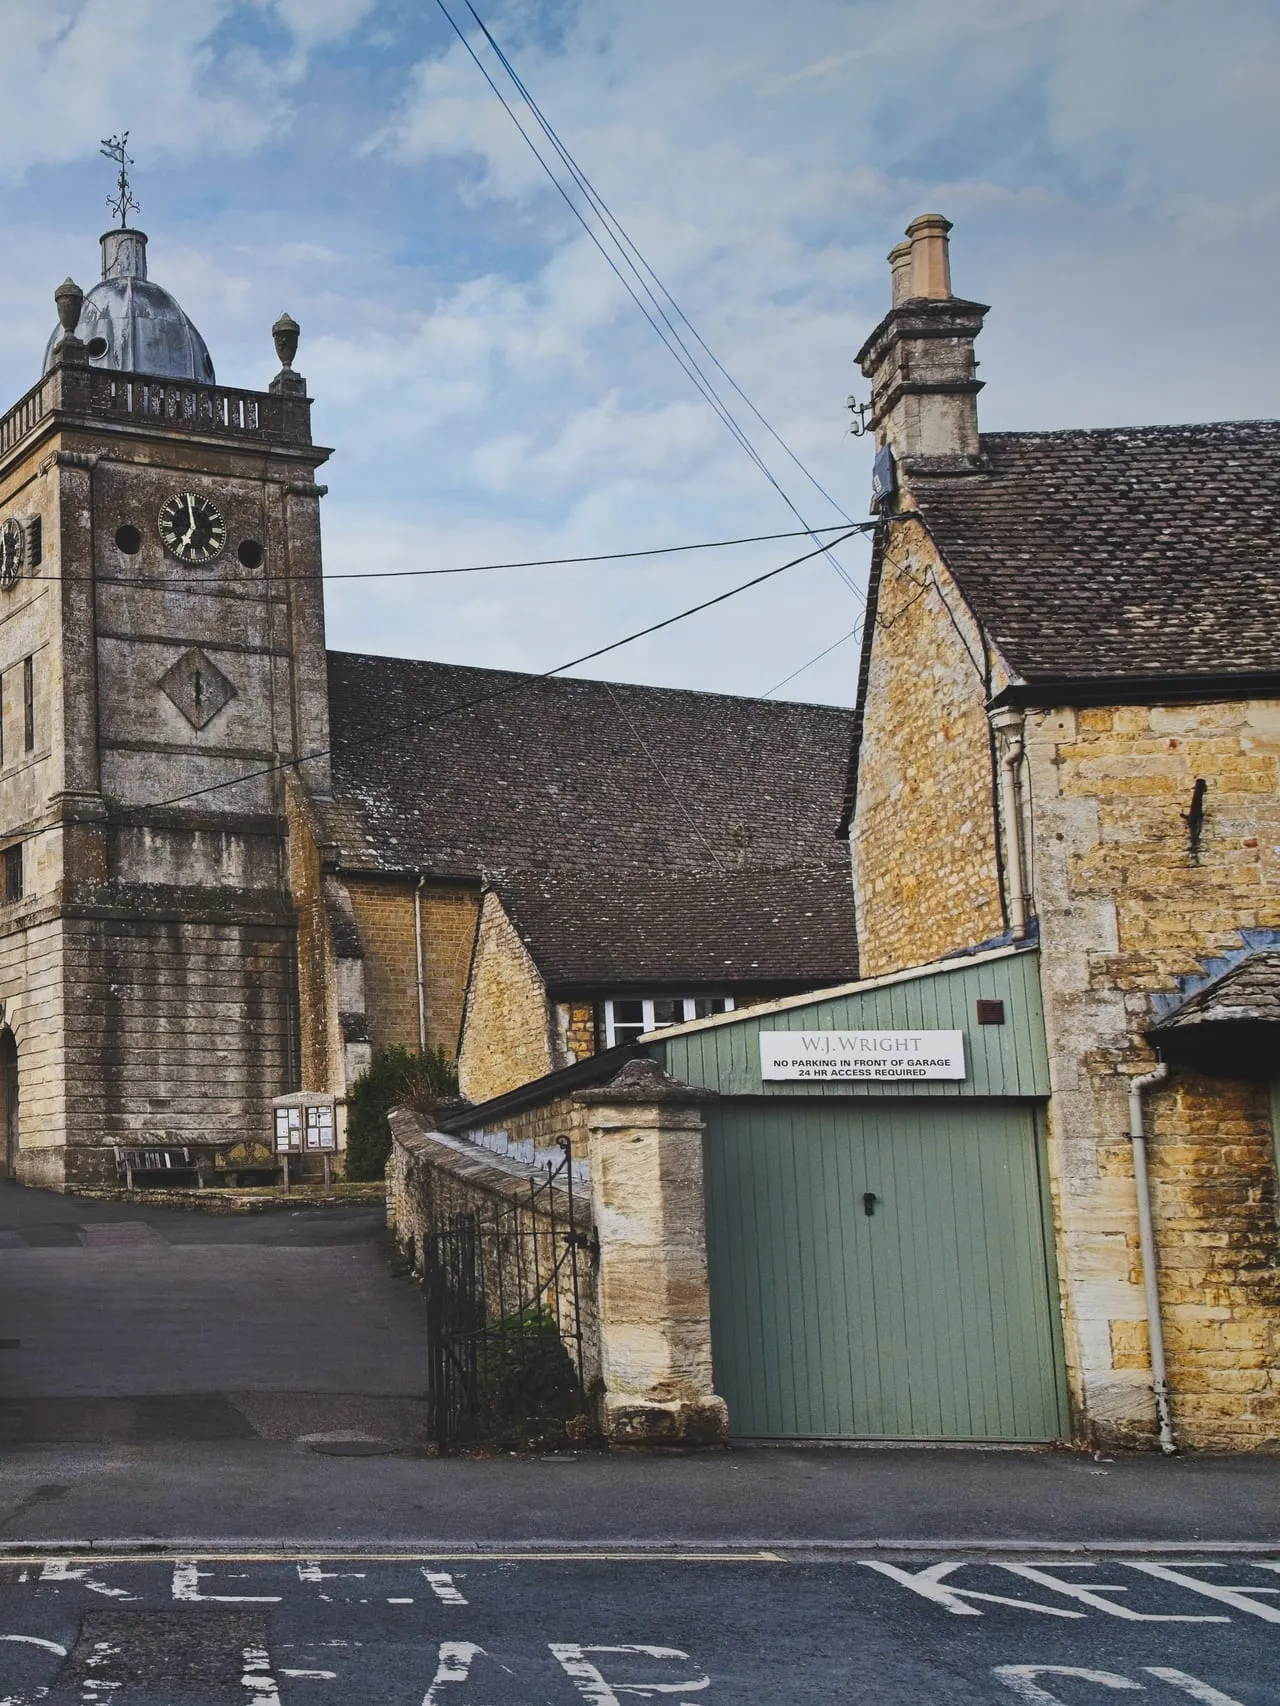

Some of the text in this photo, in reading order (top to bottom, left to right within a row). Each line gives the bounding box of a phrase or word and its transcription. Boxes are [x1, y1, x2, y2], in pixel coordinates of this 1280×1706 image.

[773, 1059, 951, 1067] NO PARKING IN FRONT OF GARAGE
[798, 1068, 927, 1077] 24 HR ACCESS REQUIRED
[857, 1562, 1280, 1623] KEE
